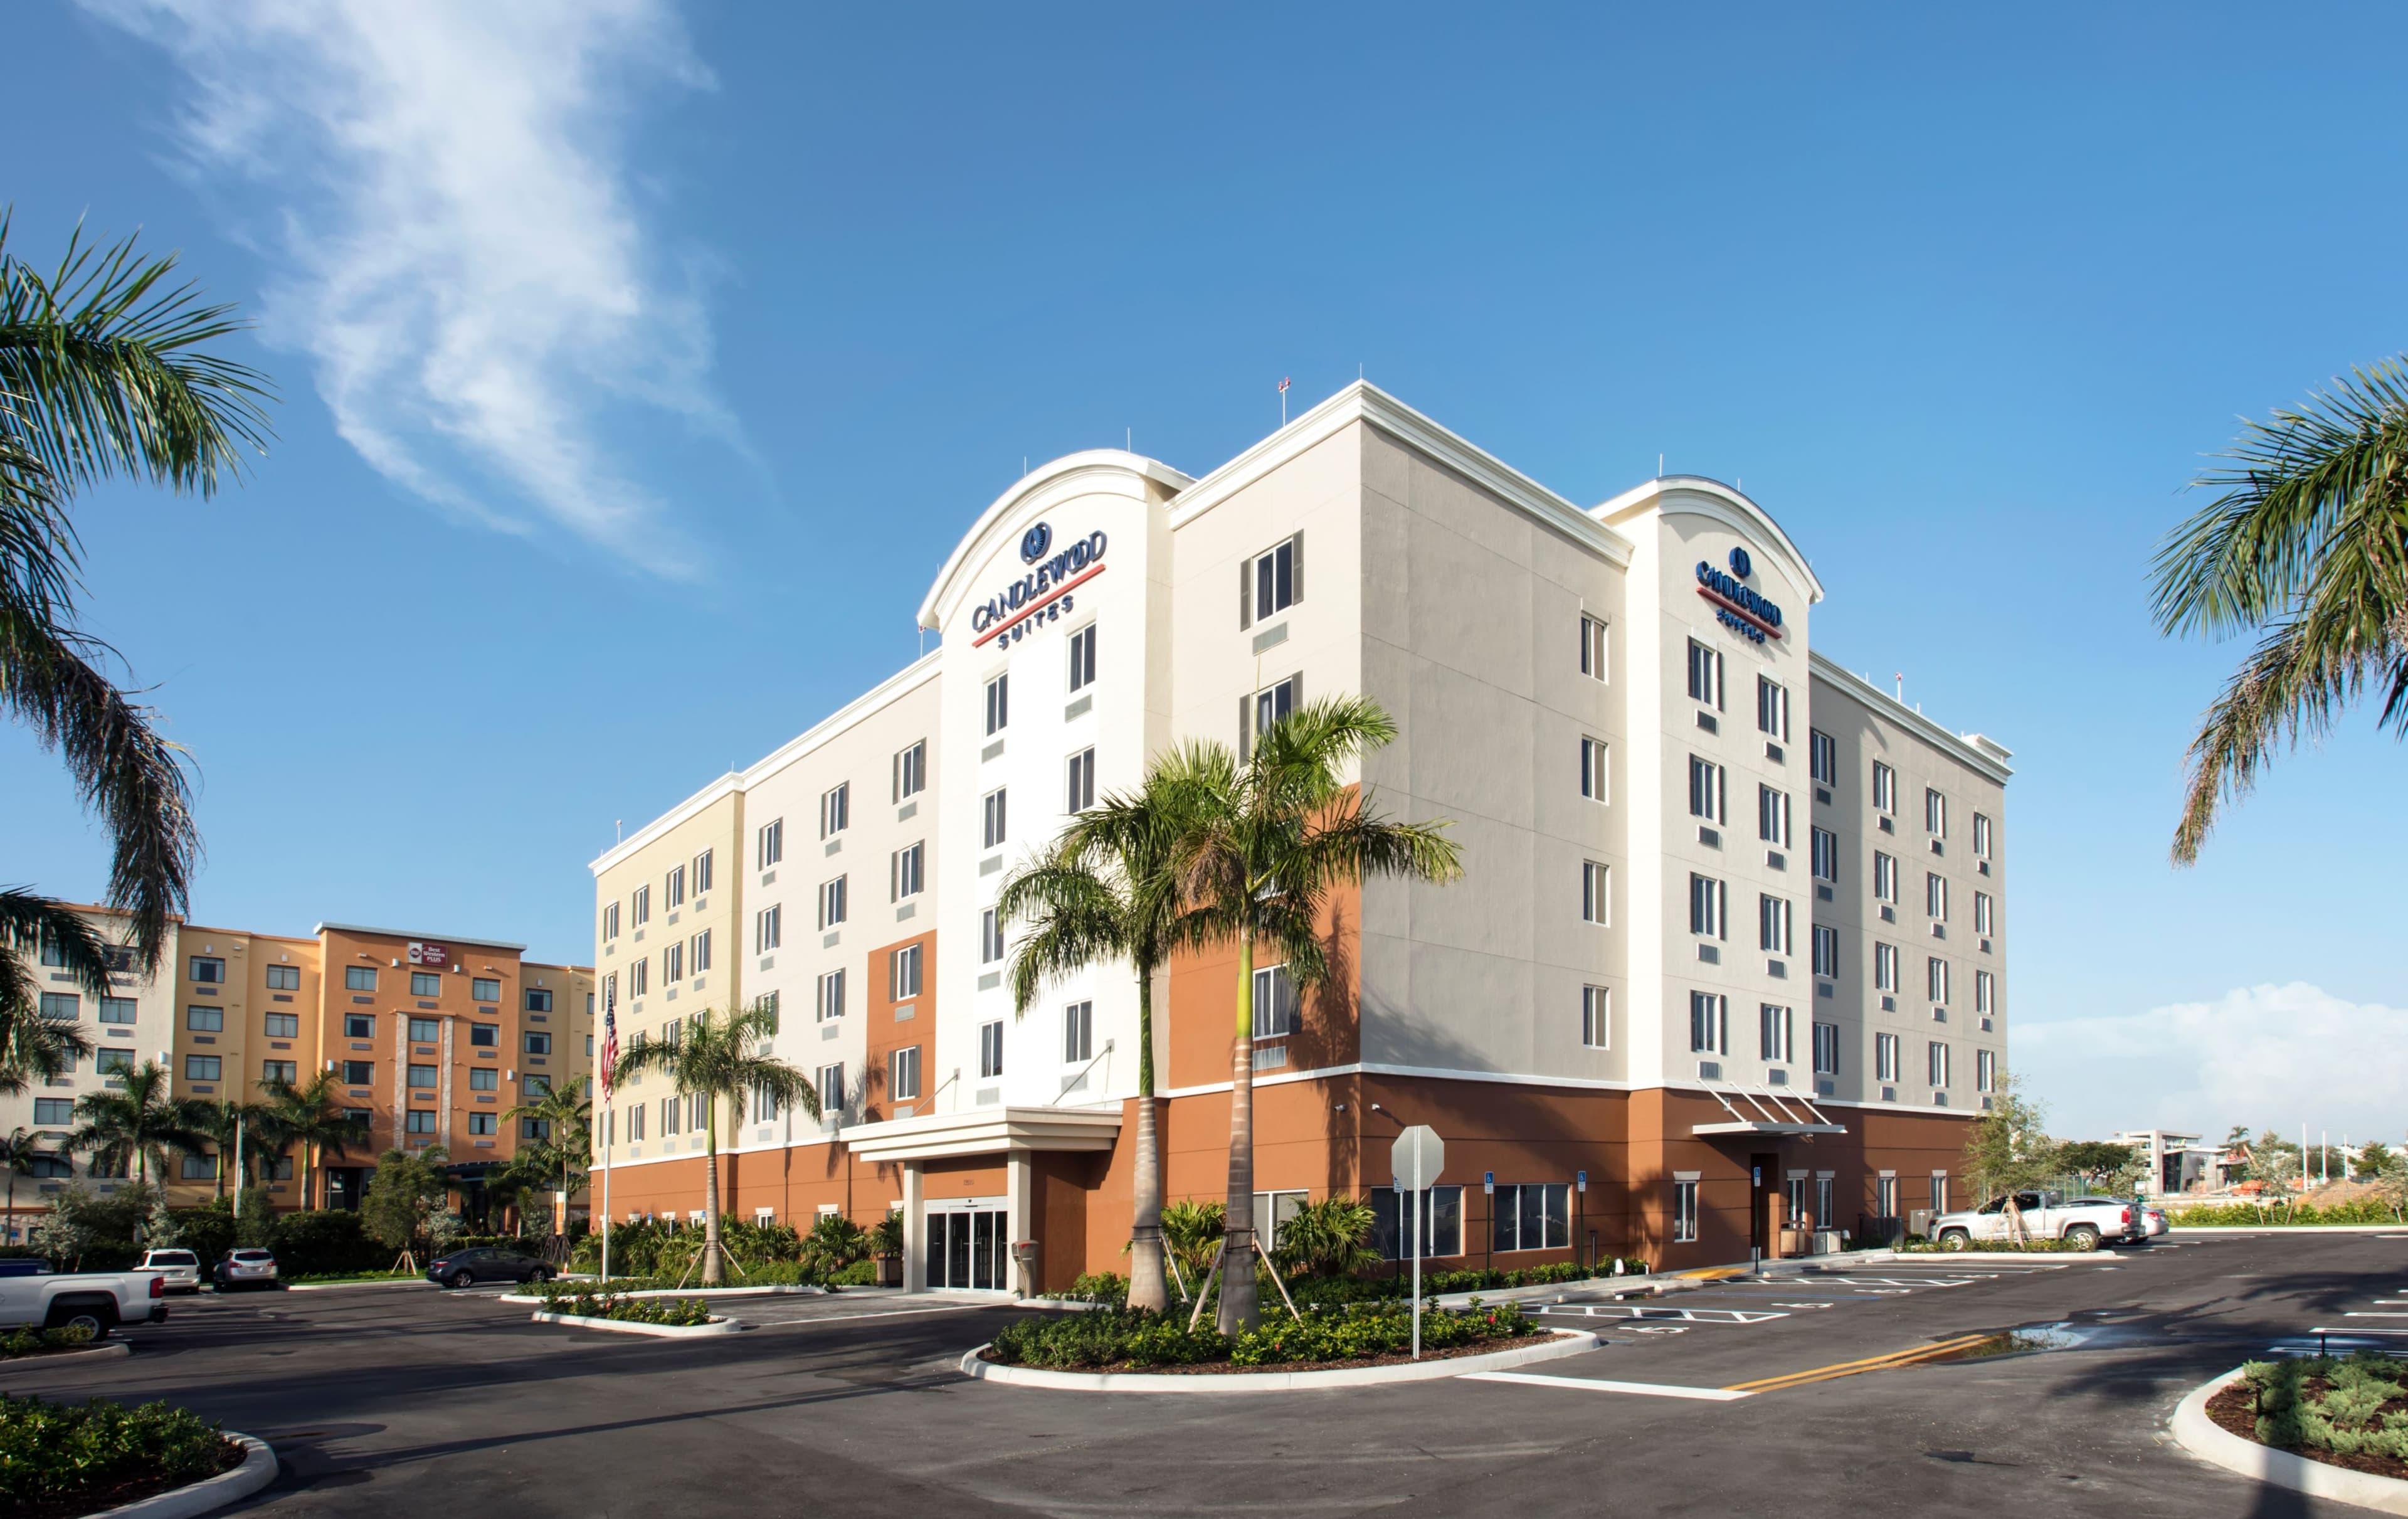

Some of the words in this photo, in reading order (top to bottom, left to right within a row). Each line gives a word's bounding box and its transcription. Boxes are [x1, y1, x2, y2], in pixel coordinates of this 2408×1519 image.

[972, 530, 1107, 633] CANDLEWOOD
[1696, 561, 1782, 627] CANDLEWOOD
[998, 595, 1074, 650] SUITES
[1716, 608, 1766, 644] SUITES
